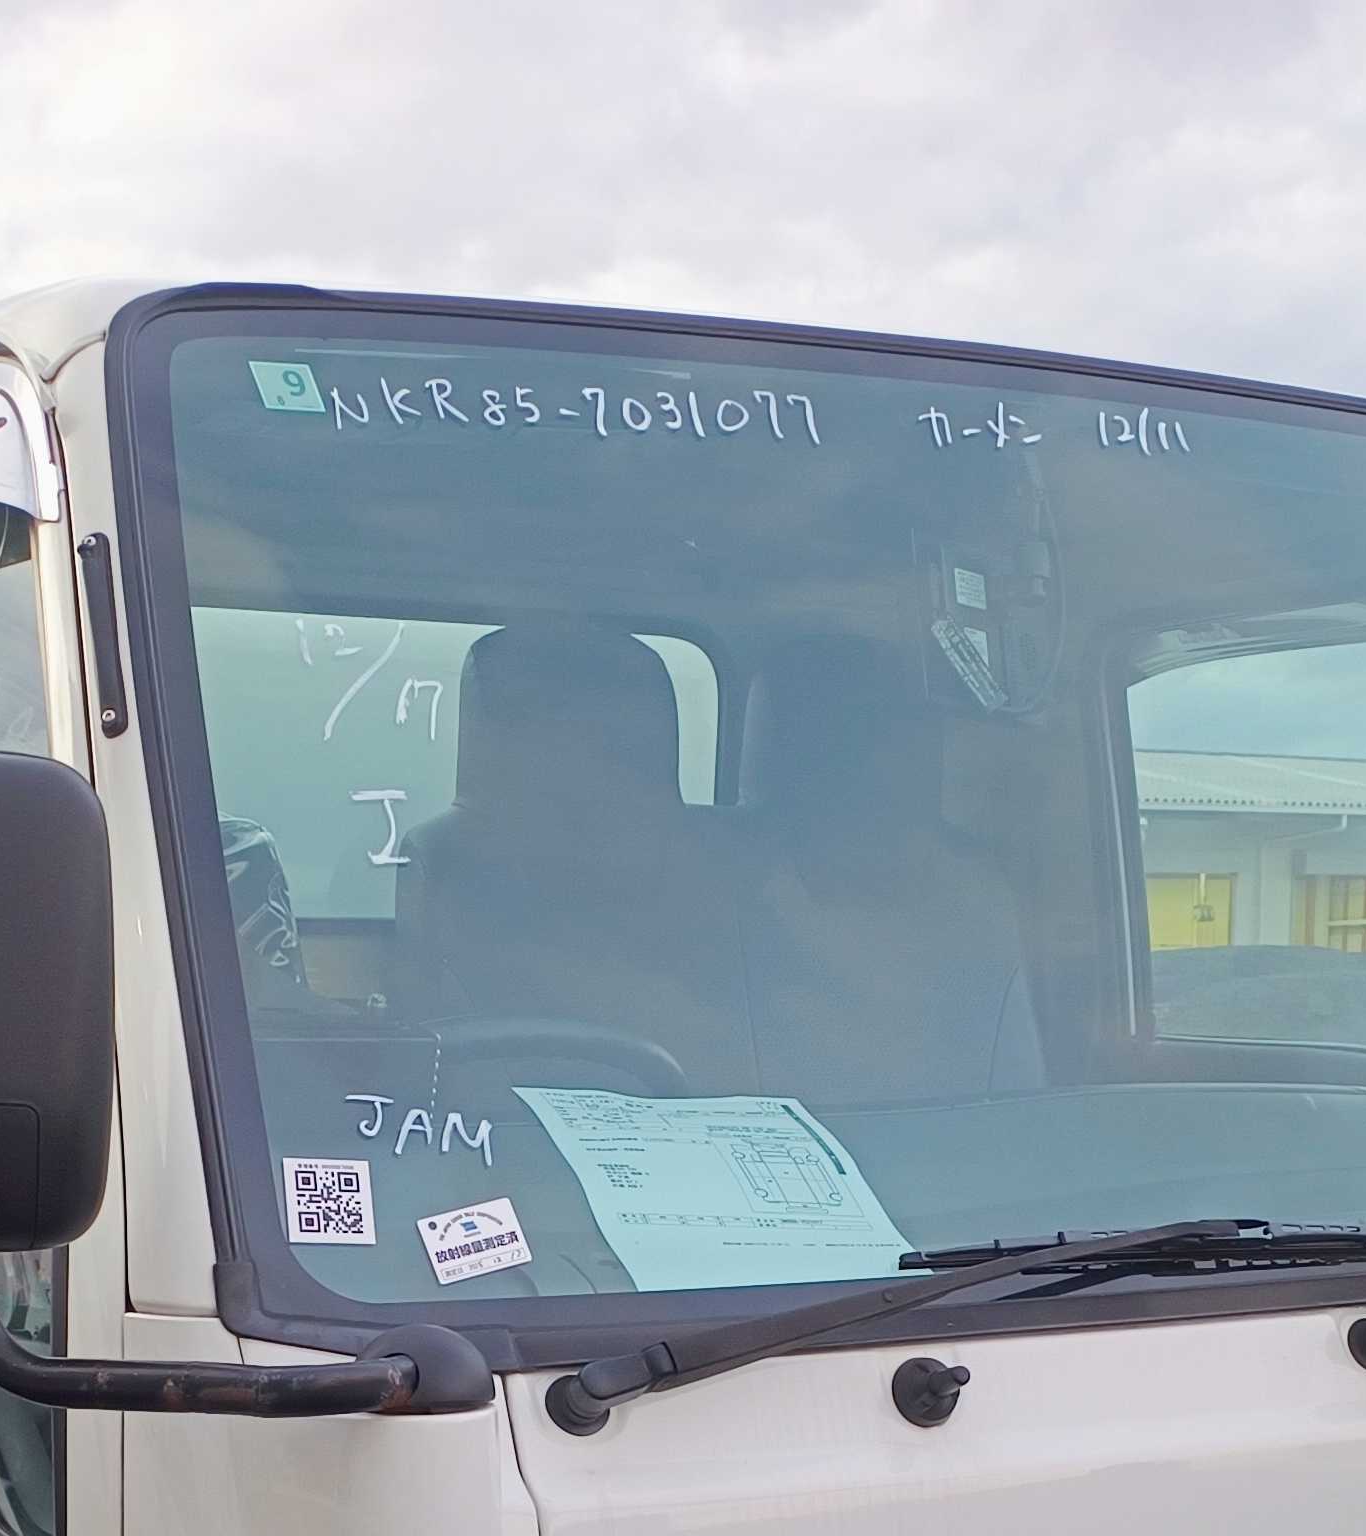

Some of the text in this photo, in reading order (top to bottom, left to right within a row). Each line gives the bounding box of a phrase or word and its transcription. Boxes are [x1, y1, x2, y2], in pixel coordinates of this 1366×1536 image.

[282, 370, 306, 397] 9
[331, 376, 821, 445] NKR85-7031077
[344, 1094, 493, 1167] JAM
